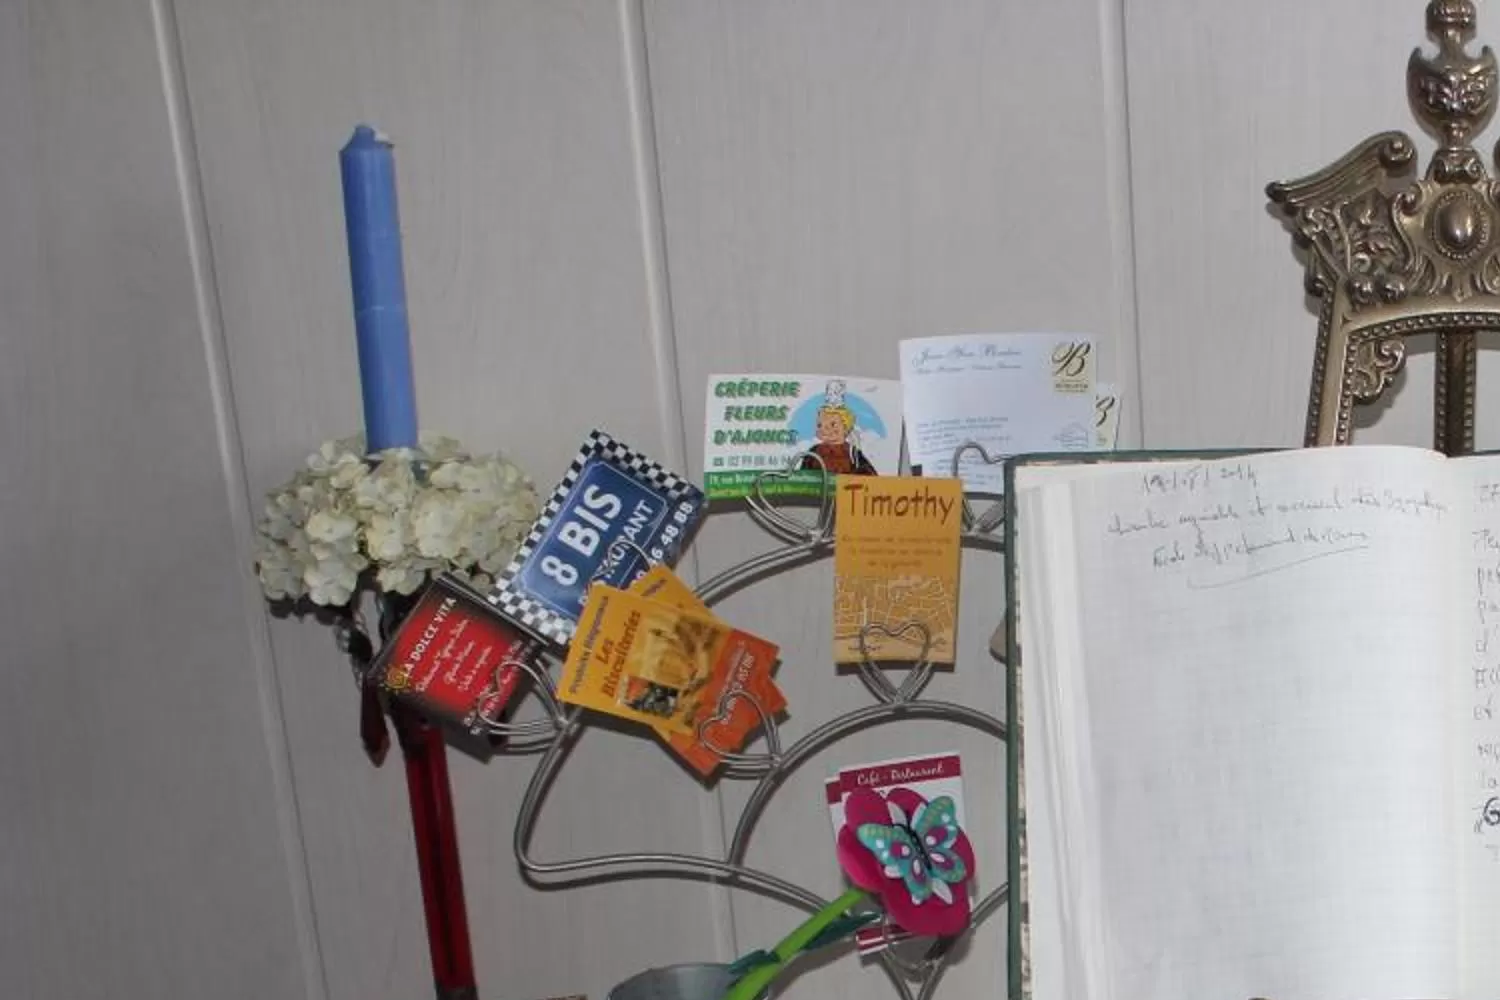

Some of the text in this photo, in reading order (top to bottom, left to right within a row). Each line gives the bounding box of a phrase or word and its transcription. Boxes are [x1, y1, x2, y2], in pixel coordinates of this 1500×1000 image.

[724, 404, 791, 422] FLEURS
[843, 484, 955, 525] Timothy
[541, 484, 622, 586] 8 BIS
[410, 624, 440, 662] DOLCE
